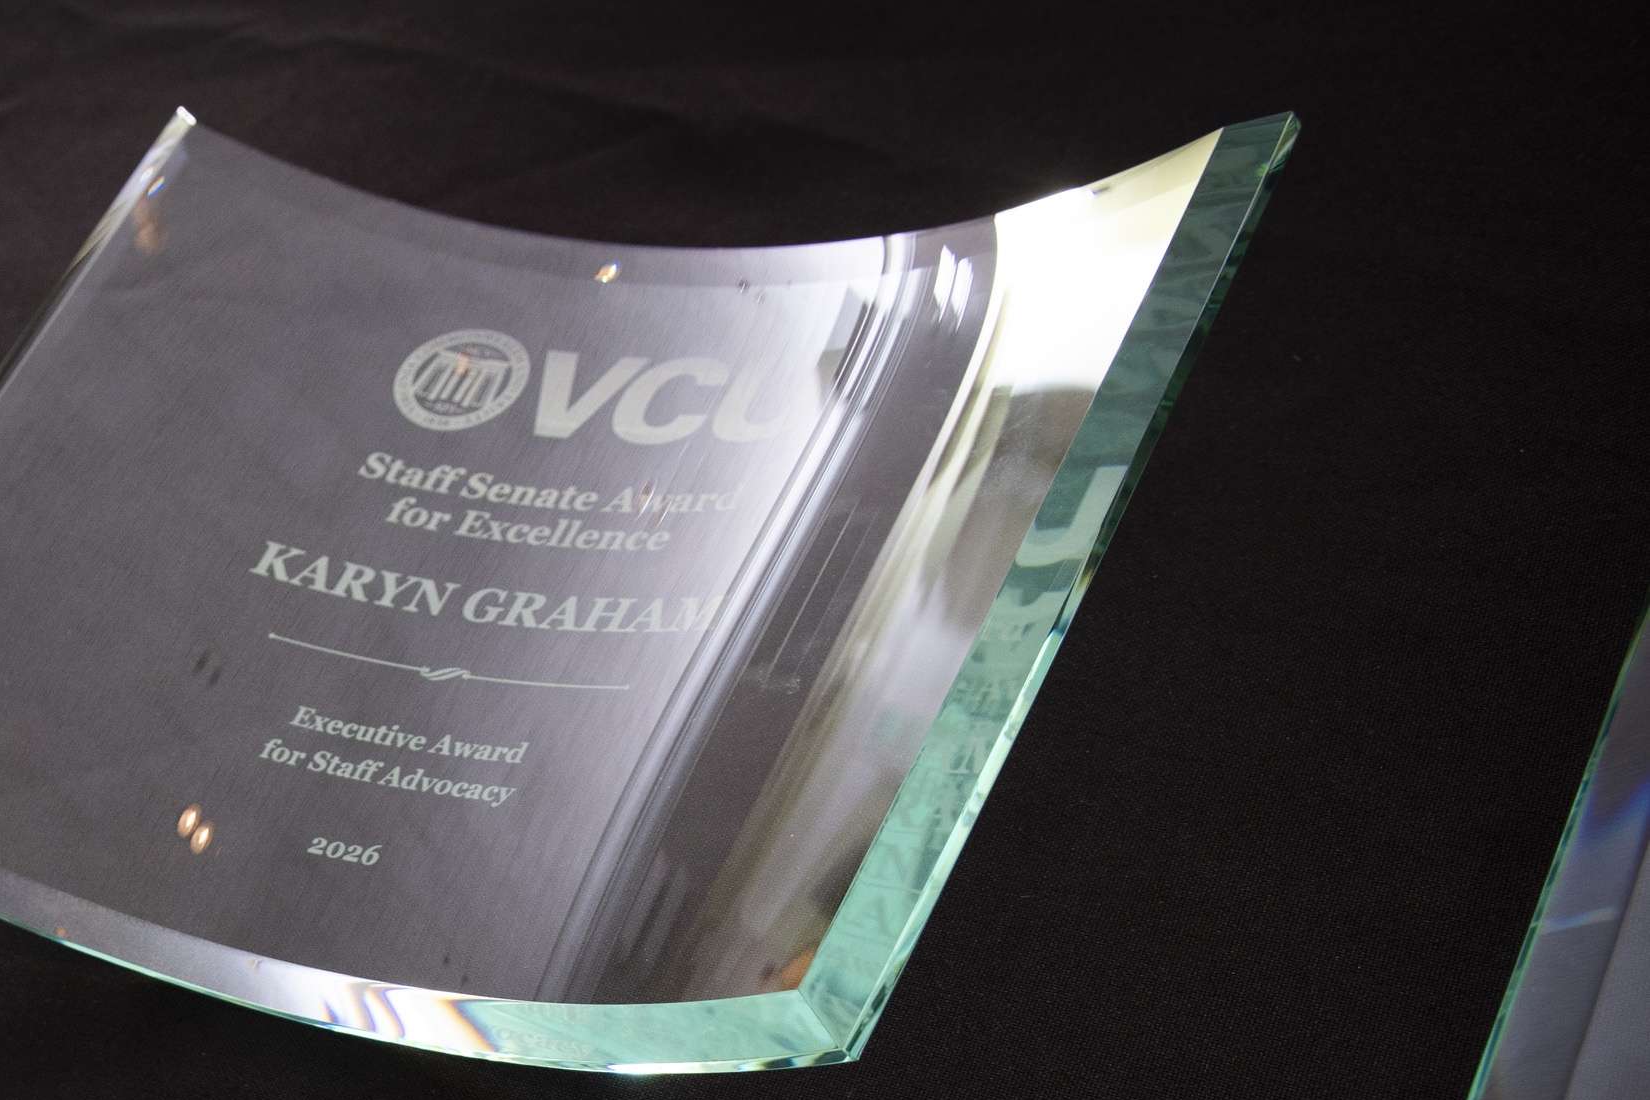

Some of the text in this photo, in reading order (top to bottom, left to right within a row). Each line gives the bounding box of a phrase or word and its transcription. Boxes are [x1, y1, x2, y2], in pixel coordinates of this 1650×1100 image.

[533, 349, 800, 446] VCU
[358, 451, 748, 515] Staff Senate Award
[385, 496, 671, 552] for Excellence
[249, 540, 732, 634] KARYN GRAHAM
[289, 704, 530, 765] Executive Award
[258, 738, 517, 807] for Staff Advocacy
[306, 835, 383, 867] 2026
